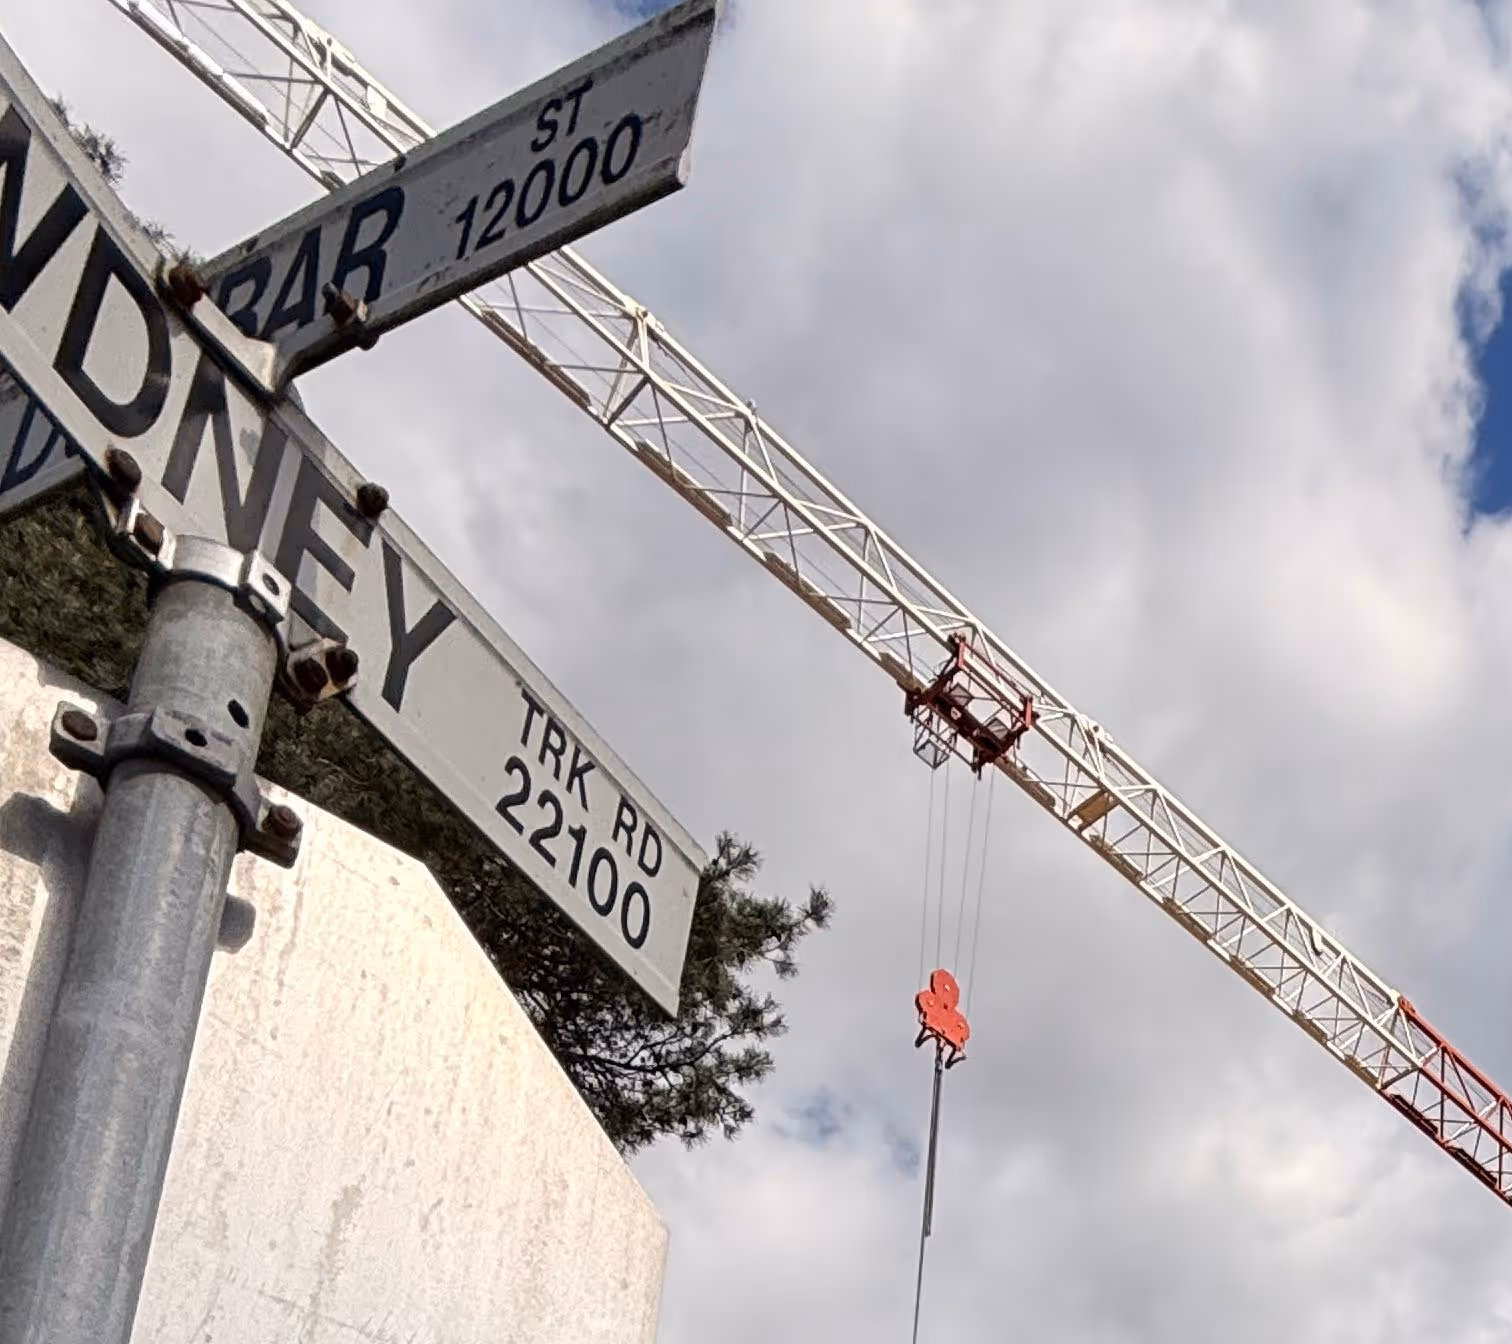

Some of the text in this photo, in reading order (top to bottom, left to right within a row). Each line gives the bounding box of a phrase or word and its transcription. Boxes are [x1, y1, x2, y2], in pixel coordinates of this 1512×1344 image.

[456, 113, 643, 260] 12000
[531, 76, 594, 153] ST
[494, 756, 651, 950] 22100
[519, 688, 663, 879] TRK RD
